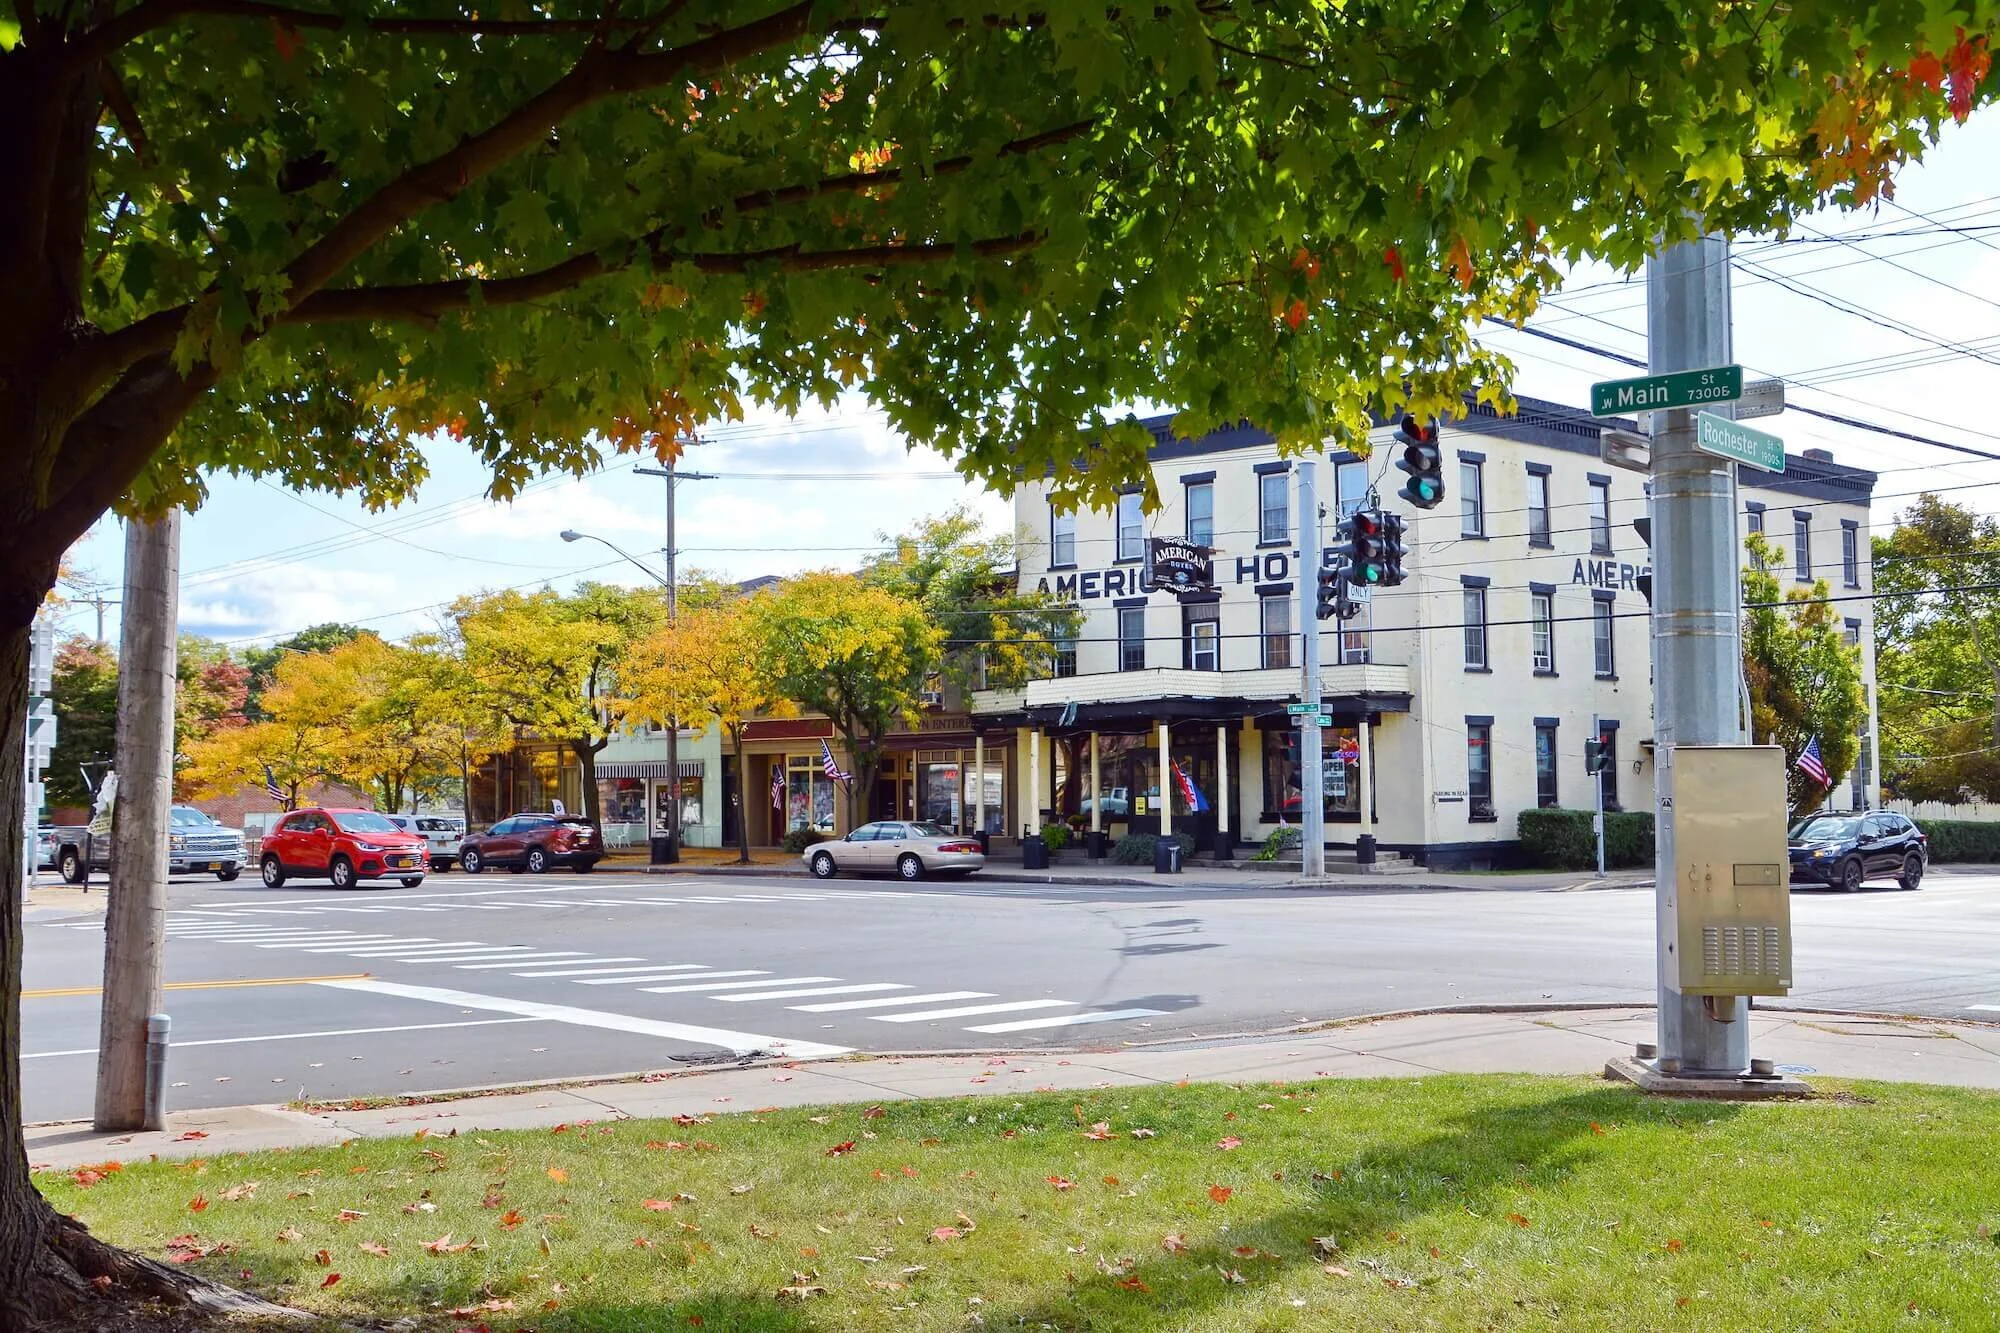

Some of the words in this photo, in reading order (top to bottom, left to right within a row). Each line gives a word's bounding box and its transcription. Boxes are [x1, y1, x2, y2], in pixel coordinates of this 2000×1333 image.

[1701, 374, 1714, 385] St
[1603, 397, 1613, 409] W
[1618, 383, 1668, 407] Main
[1687, 386, 1730, 400] 7300E
[1704, 421, 1758, 457] Rochester
[1155, 547, 1206, 571] AMERICAN
[1170, 560, 1194, 570] HOTEL
[1037, 567, 1158, 600] AMERIC
[1350, 586, 1368, 599] ONLY
[1323, 761, 1344, 772] OPEN
